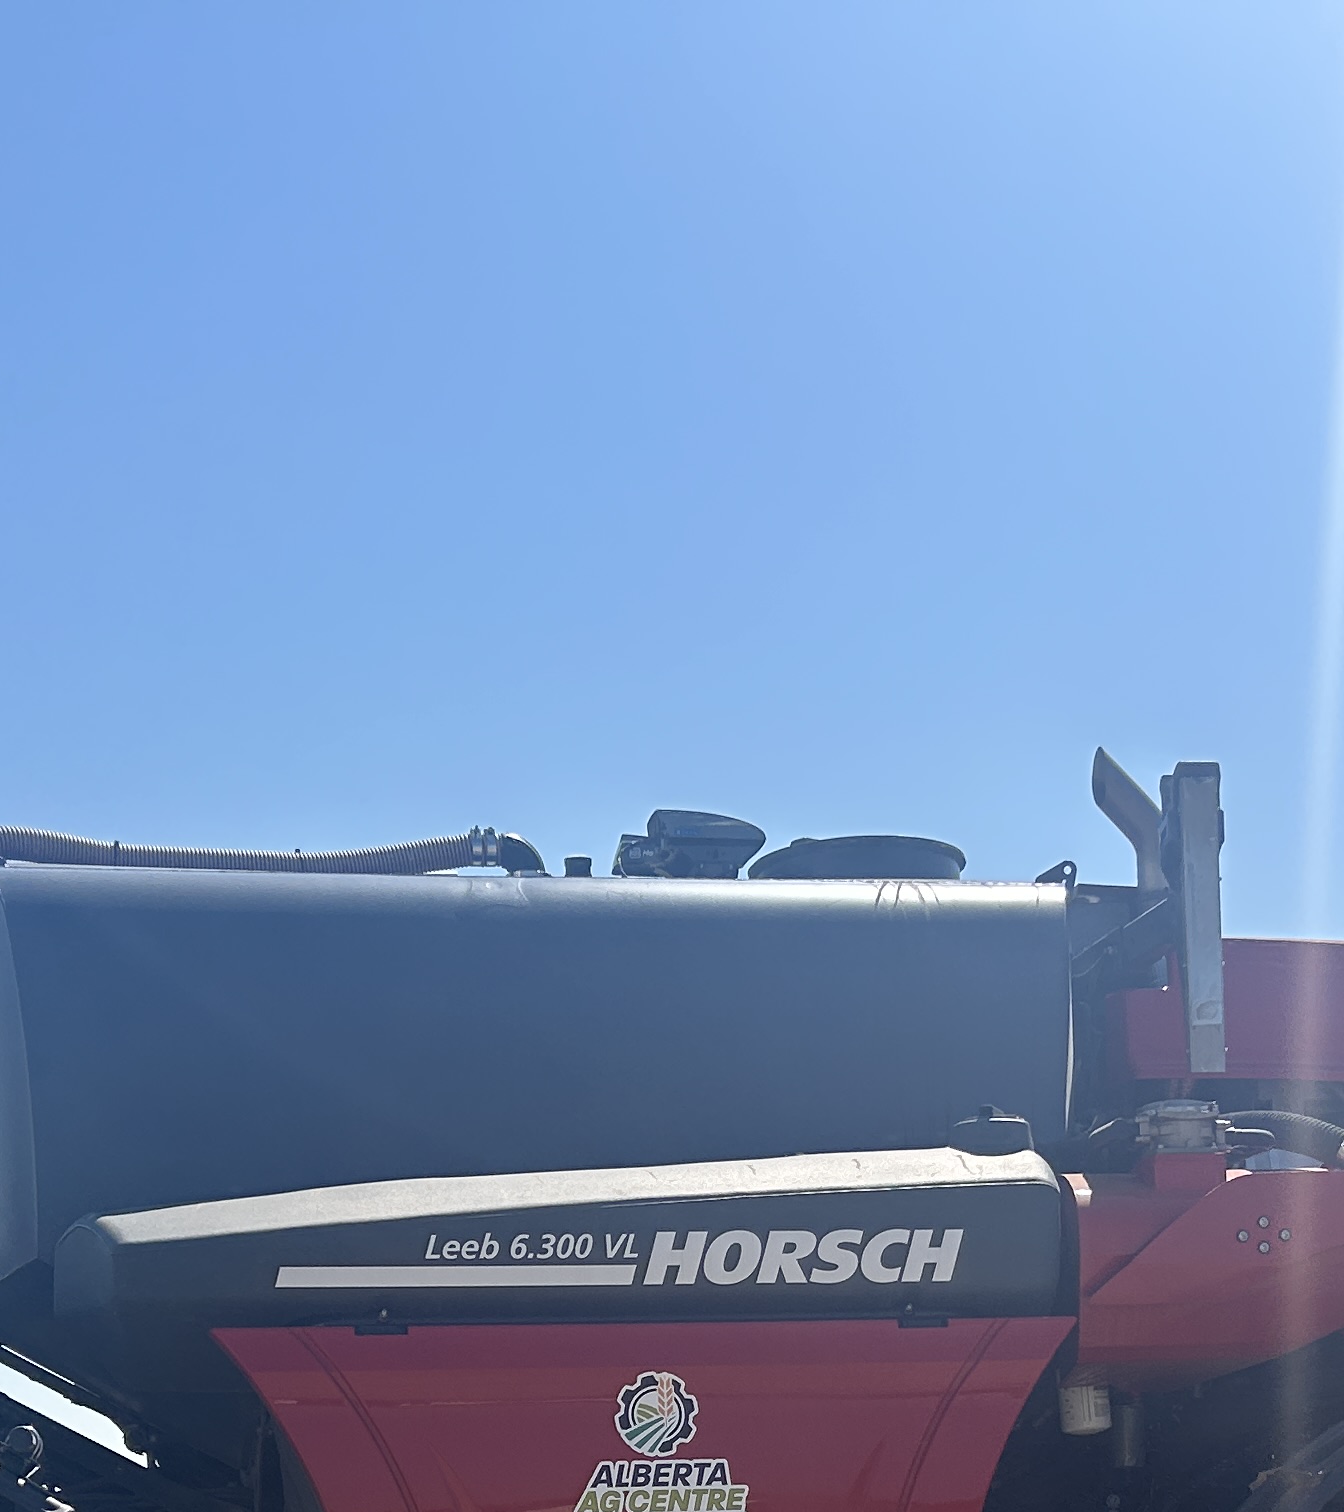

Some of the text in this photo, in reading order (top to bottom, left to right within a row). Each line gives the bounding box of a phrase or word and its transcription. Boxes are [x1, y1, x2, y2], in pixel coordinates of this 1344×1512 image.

[425, 1232, 639, 1260] Leeb 6.300 VL
[642, 1229, 964, 1285] HORSCH
[591, 1462, 728, 1488] ALBERTA
[628, 1488, 746, 1512] CENTRE
